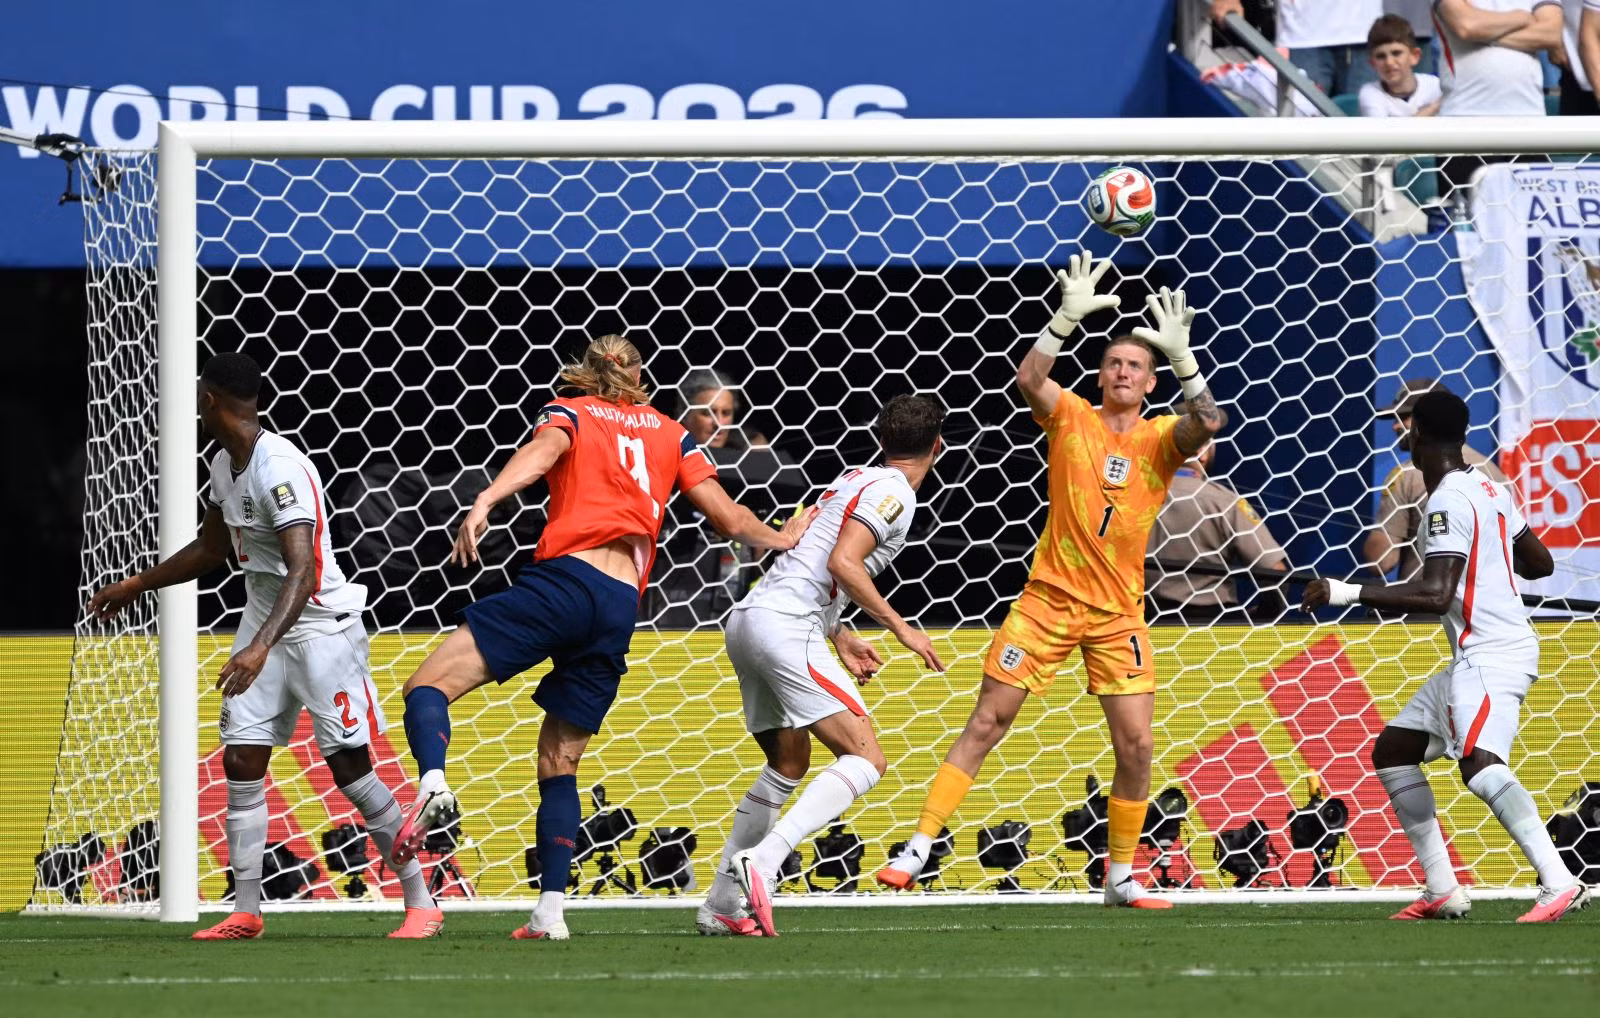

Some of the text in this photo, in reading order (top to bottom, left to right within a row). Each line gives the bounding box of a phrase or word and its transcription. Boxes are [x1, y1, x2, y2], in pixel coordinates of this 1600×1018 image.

[1519, 177, 1568, 193] WEST
[617, 433, 659, 520] 9
[1097, 504, 1114, 537] 1
[1129, 634, 1142, 667] 1
[333, 691, 358, 728] 2
